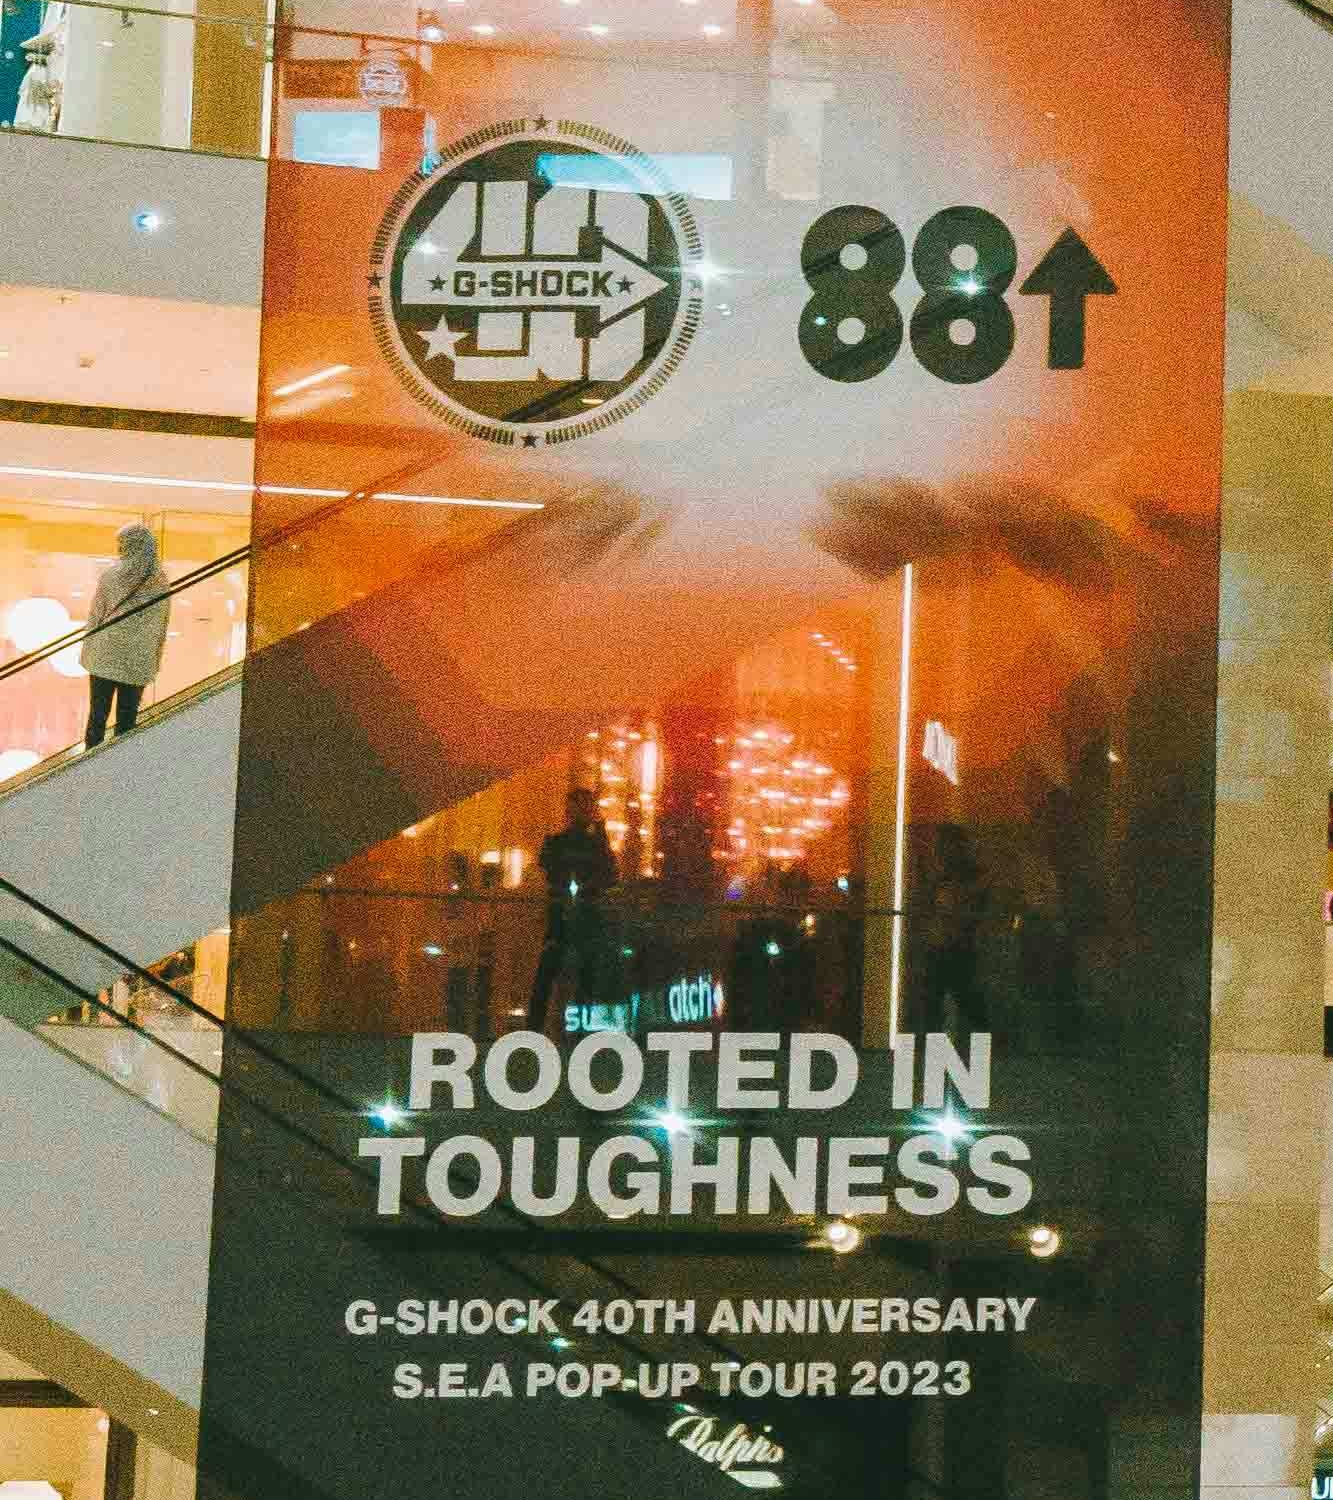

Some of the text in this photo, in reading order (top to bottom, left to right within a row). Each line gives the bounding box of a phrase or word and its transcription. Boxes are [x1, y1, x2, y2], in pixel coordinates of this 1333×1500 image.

[453, 269, 614, 298] G-SHOCK
[408, 1033, 992, 1112] ROOTED IN
[360, 1135, 1033, 1217] TOUGHNESS
[344, 1297, 1038, 1335] G-SHOCK 40TH ANNIVERSARY
[393, 1360, 971, 1399] S.E.A POP-UP TOUR 2023
